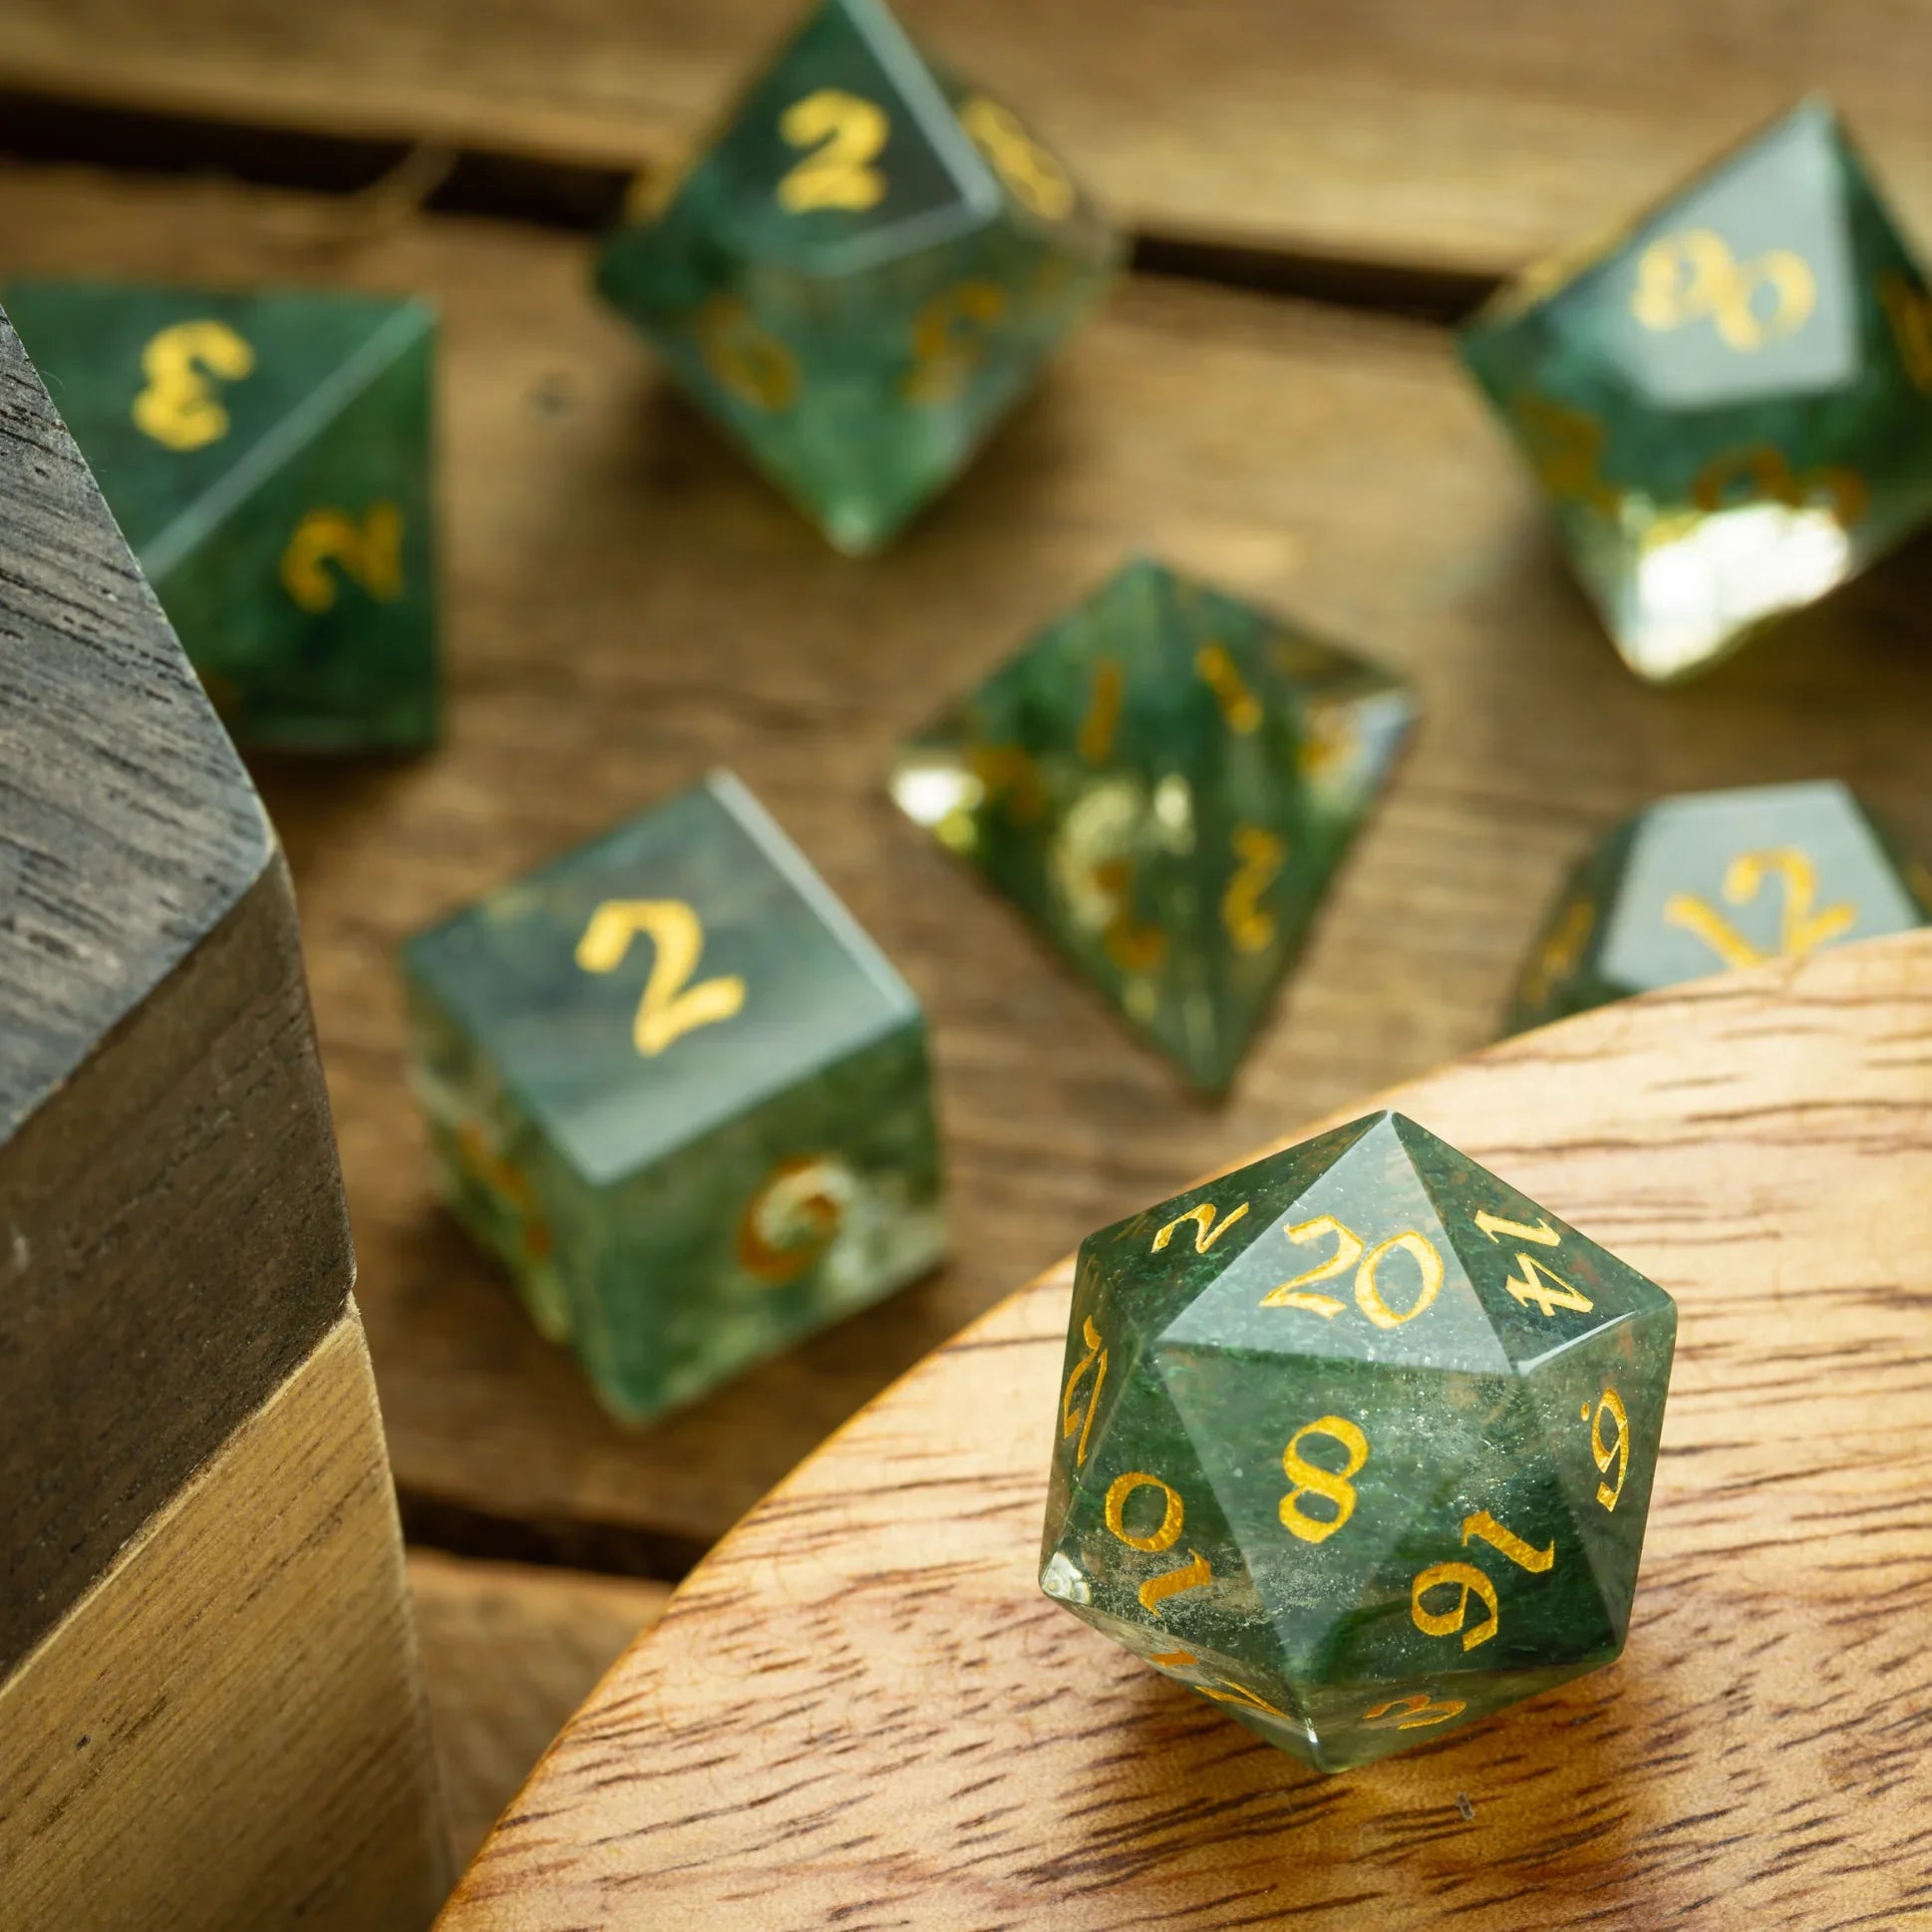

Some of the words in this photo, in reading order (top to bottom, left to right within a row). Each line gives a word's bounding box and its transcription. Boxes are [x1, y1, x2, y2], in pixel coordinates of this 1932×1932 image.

[778, 88, 890, 214] 2
[132, 318, 256, 453] 3
[574, 898, 746, 1058] 2
[1150, 1202, 1250, 1255] 2
[1258, 1213, 1445, 1330] 20
[1474, 1209, 1594, 1318] 14
[1277, 1415, 1370, 1544] 8
